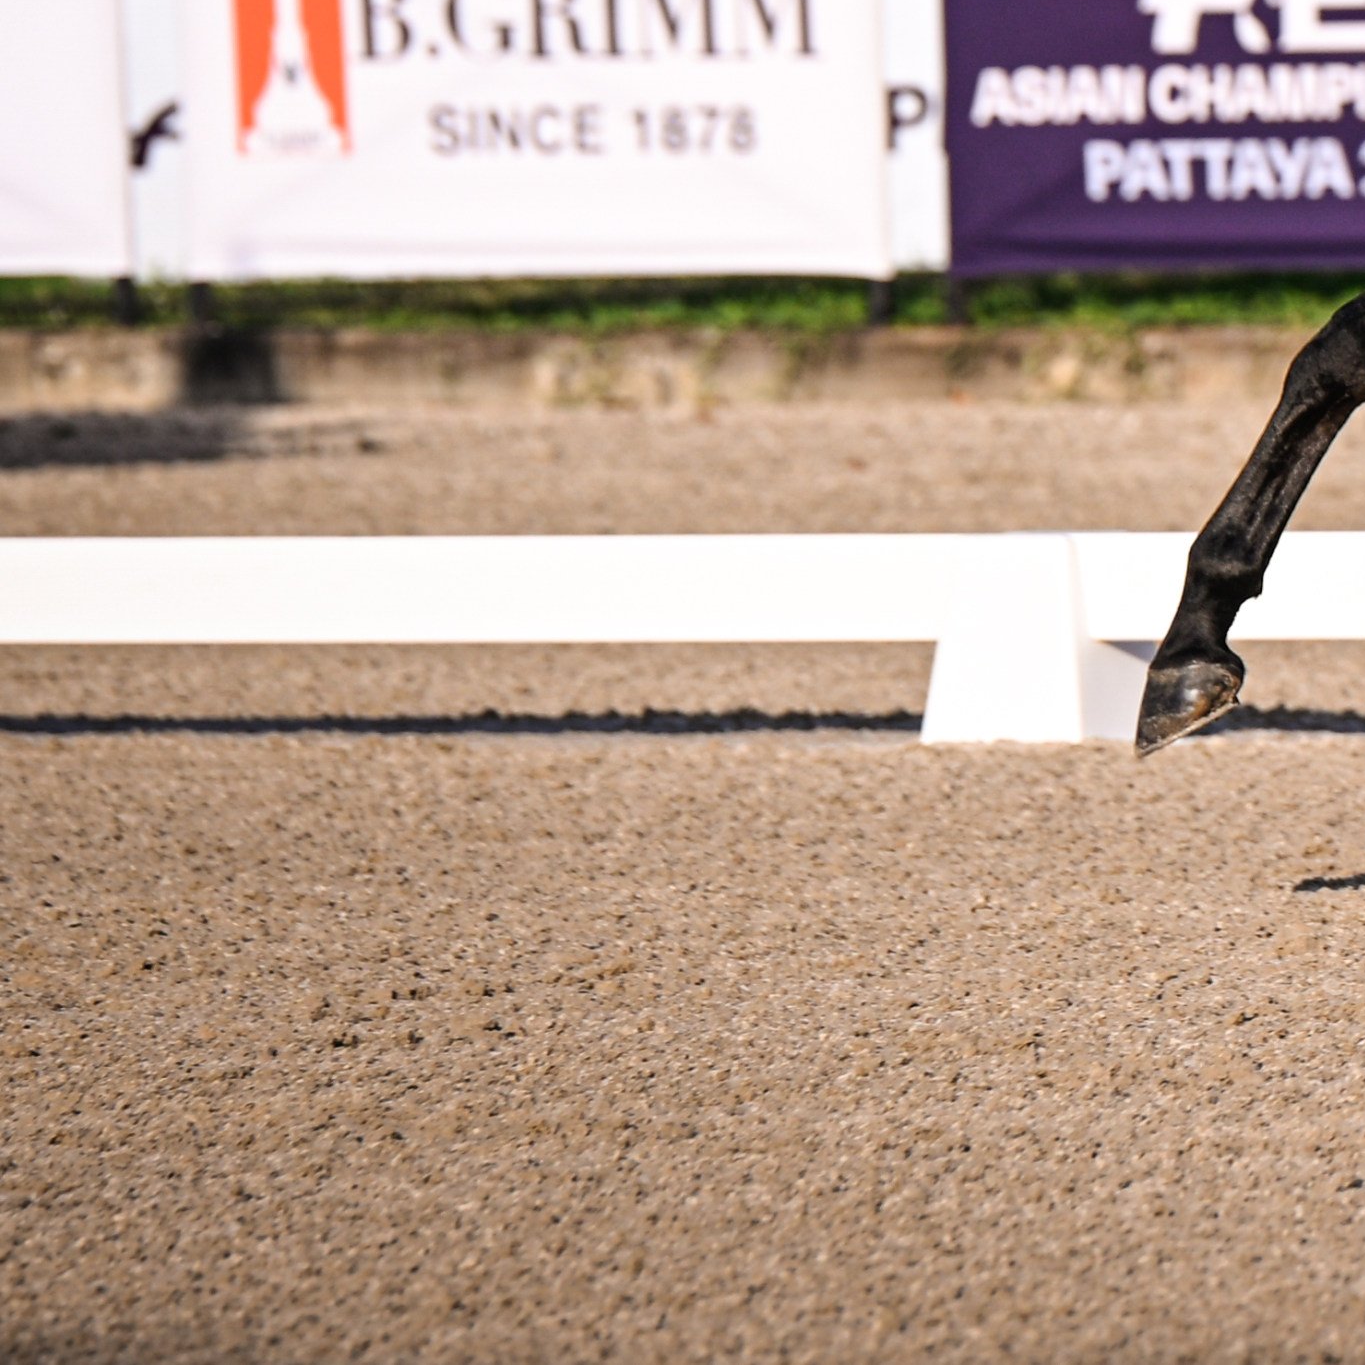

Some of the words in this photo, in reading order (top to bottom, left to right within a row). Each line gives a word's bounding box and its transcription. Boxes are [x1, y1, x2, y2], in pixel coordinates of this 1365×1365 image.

[969, 63, 1146, 128] ASIAN
[430, 103, 606, 156] SINCE
[634, 103, 758, 154] 1878
[1083, 138, 1355, 202] PATTAYA
